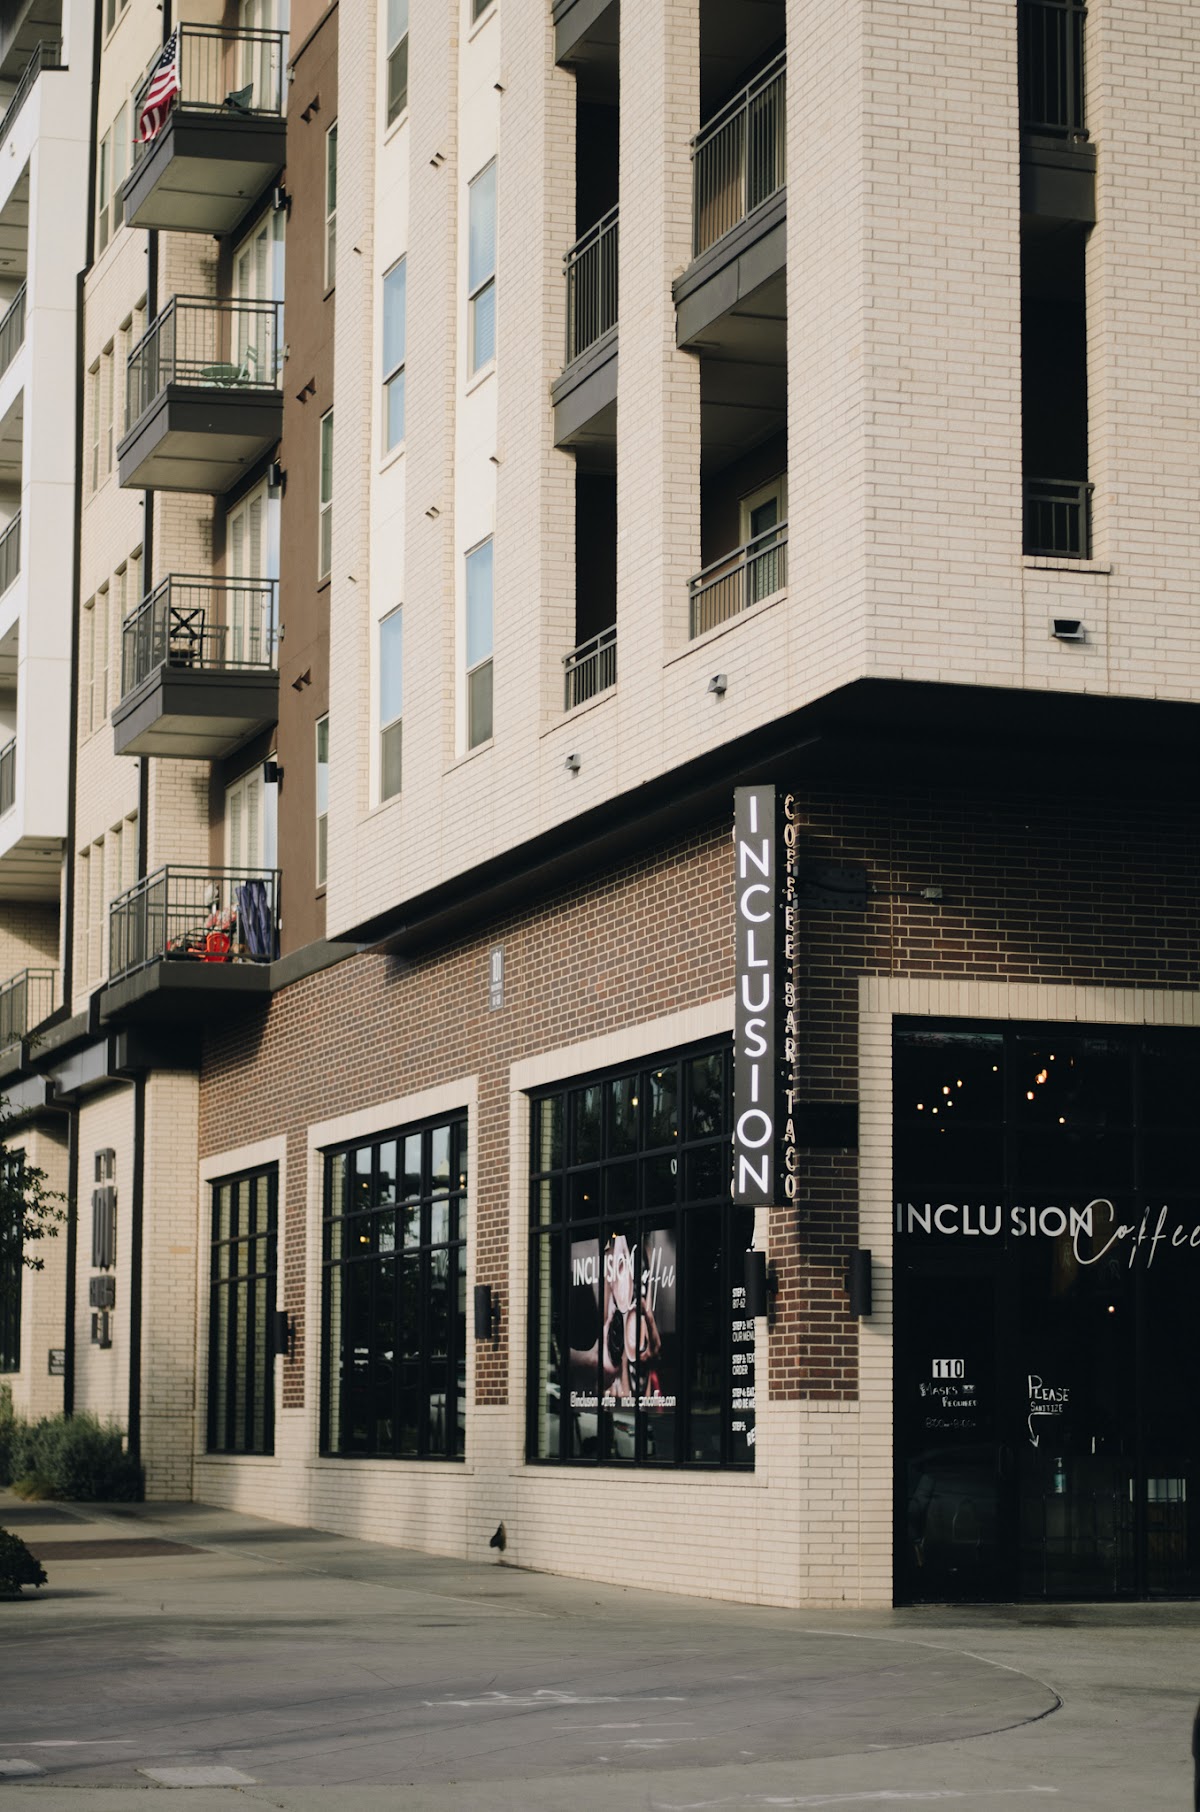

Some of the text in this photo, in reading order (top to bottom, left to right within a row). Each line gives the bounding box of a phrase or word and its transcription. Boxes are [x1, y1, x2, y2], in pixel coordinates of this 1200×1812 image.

[737, 795, 772, 1194] INCLUSION
[784, 794, 796, 1198] COFFEE BAR TACO
[896, 1203, 1093, 1237] INCLUSION
[935, 1361, 962, 1377] 110
[570, 1391, 616, 1407] @inclusionoffee
[1028, 1374, 1069, 1402] PLEASE
